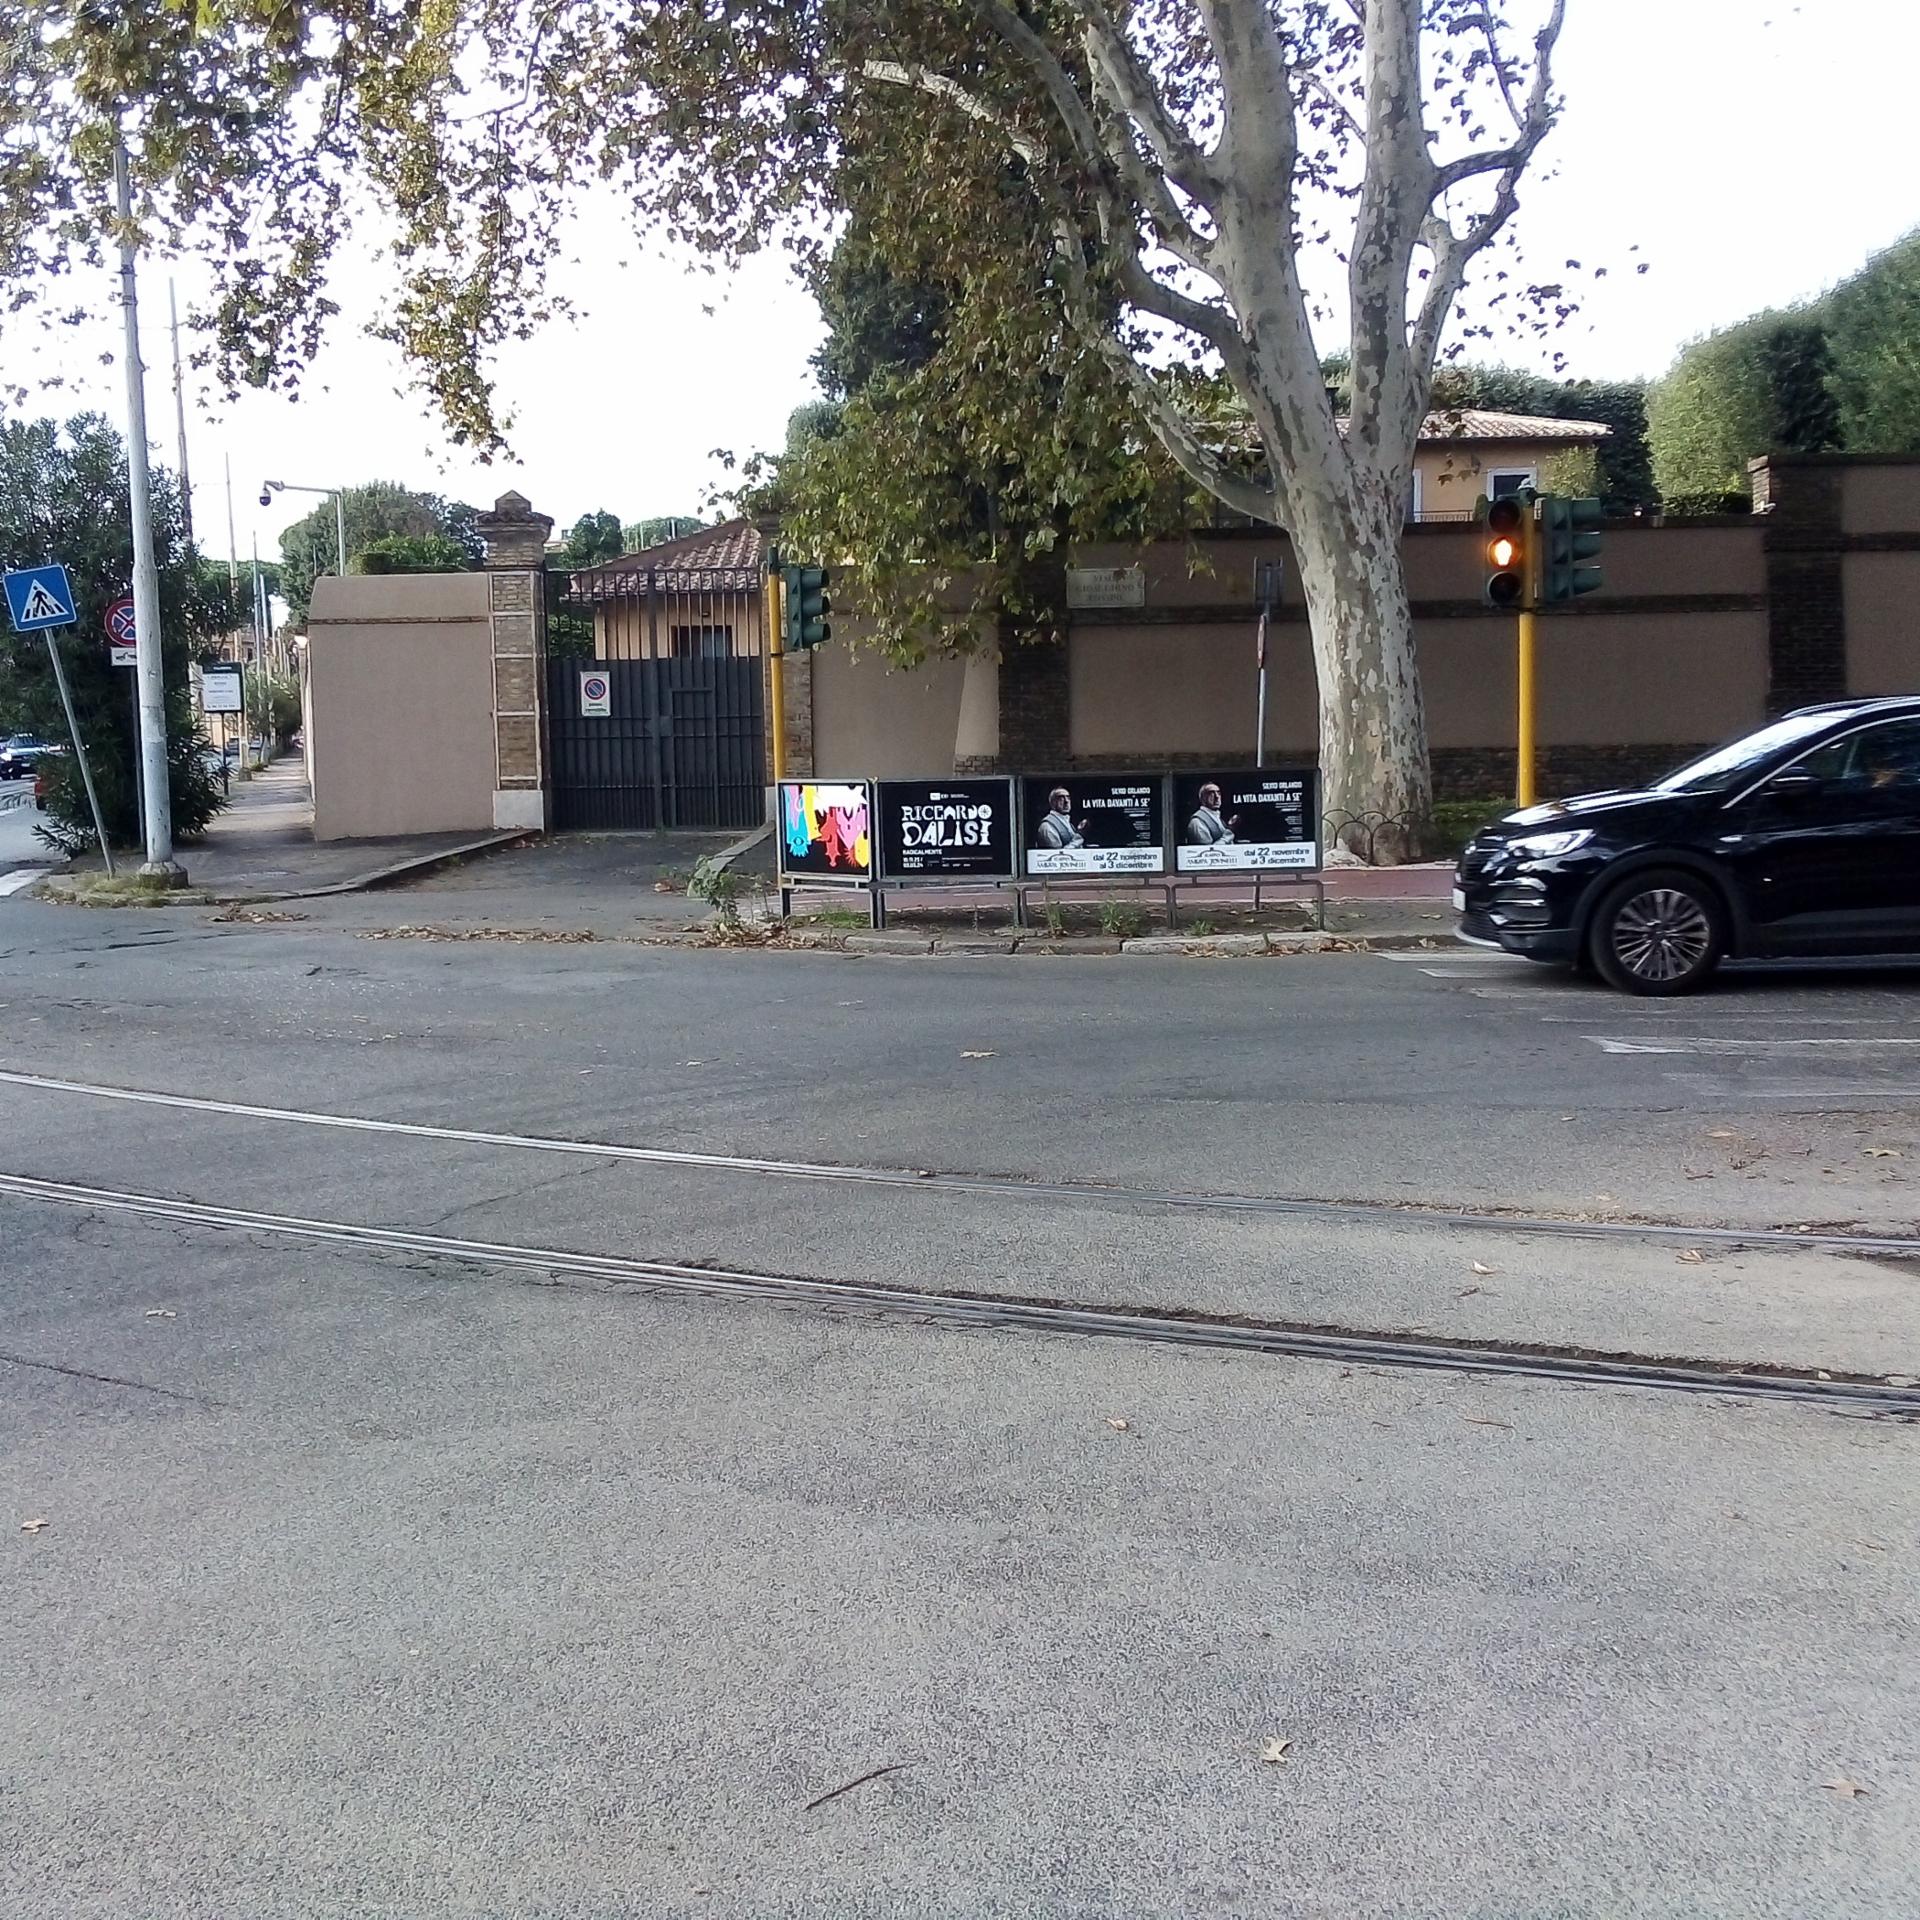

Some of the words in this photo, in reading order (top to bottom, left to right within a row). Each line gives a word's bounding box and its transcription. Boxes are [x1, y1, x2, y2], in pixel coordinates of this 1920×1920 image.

[1279, 781, 1302, 789] ORLANDO
[1083, 799, 1091, 808] LA
[1092, 799, 1106, 808] VITA
[1107, 798, 1133, 807] DAVANTI
[1134, 798, 1139, 806] A
[1233, 794, 1242, 803] LA
[1243, 794, 1257, 803] VITA
[1258, 793, 1285, 802] DAVANTI
[1286, 793, 1291, 801] A
[901, 804, 992, 821] RICCARDO
[902, 820, 992, 846] DALISI
[1093, 853, 1104, 861] dal
[1106, 851, 1118, 861] 22
[1120, 852, 1158, 861] novembre
[1257, 847, 1270, 856] 22
[1271, 848, 1310, 856] novembre
[1099, 861, 1107, 869] al
[1108, 860, 1114, 869] 3
[1116, 860, 1154, 869] dicembre
[1251, 857, 1258, 865] al
[1259, 856, 1265, 864] 3
[1267, 856, 1306, 864] dicembre
